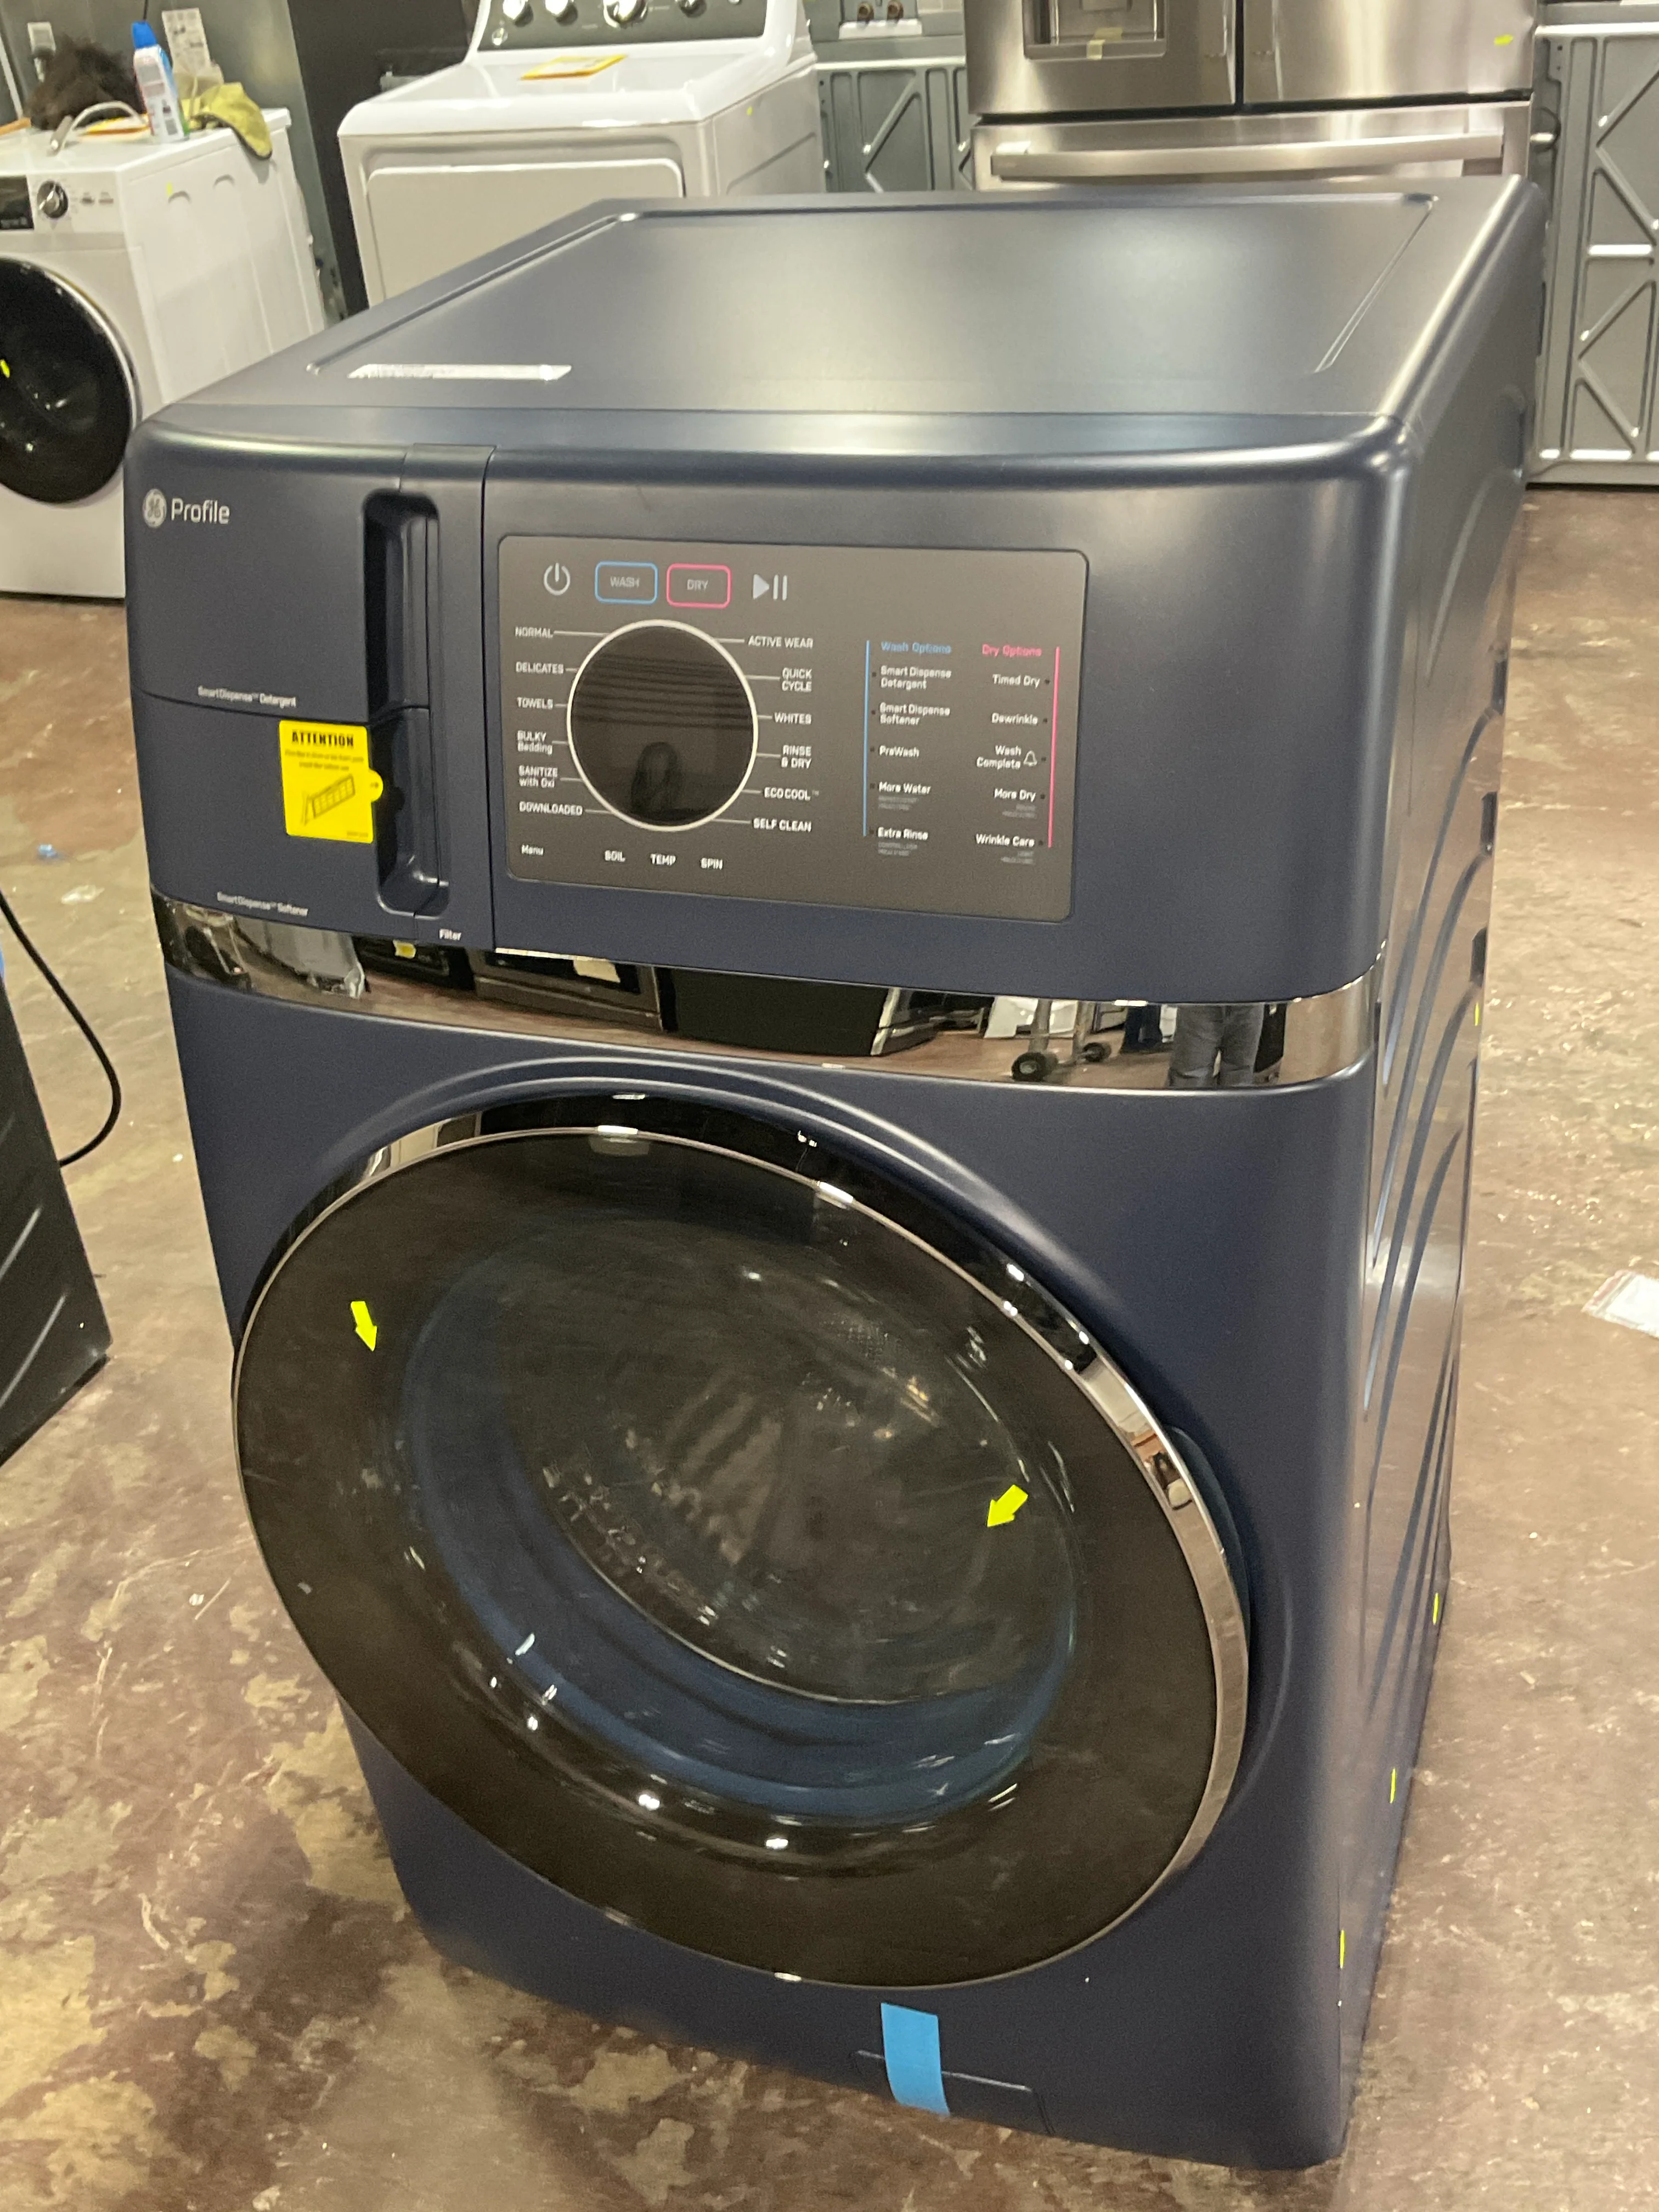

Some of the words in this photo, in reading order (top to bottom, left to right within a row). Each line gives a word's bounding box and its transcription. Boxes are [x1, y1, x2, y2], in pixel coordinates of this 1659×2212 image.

[171, 498, 230, 524] Profile
[610, 575, 640, 588] WASH
[687, 579, 708, 591] DRY
[515, 627, 553, 638] NORMAL
[748, 636, 782, 648] ACTIVE
[785, 637, 814, 648] WEAR
[881, 641, 909, 652] Wash
[912, 642, 951, 654] Options
[982, 644, 999, 657] Dry
[1002, 645, 1042, 657] Options
[516, 663, 564, 674] DELICATES
[782, 668, 812, 680] QUICK
[881, 665, 907, 677] Smart
[910, 667, 952, 679] Dispense
[782, 681, 812, 692] CYCLE
[881, 678, 927, 691] Detergent
[992, 674, 1021, 685] Timed
[1023, 675, 1040, 689] Dry
[517, 698, 554, 709] TOWELS
[879, 702, 907, 714] Smart
[909, 704, 951, 716] Dispense
[774, 713, 812, 725] WHITES
[879, 714, 920, 725] Softener
[991, 713, 1039, 725] Dewrinkle
[292, 732, 354, 746] ATTENTION
[517, 731, 546, 741] BULKY
[517, 743, 553, 755] Bedding
[782, 746, 812, 757] RINSE
[879, 746, 920, 758] PreWash
[995, 746, 1022, 756] Wash
[781, 758, 788, 768] &
[791, 758, 812, 769] DRY
[977, 757, 1021, 770] Complete
[518, 766, 558, 777] SANITIZE
[519, 777, 538, 787] with
[879, 782, 901, 793] More
[903, 784, 932, 794] Water
[994, 788, 1017, 799] More
[1019, 789, 1036, 802] Dry
[519, 802, 583, 816] DOWNLOADED
[753, 818, 777, 830] SELF
[779, 820, 812, 832] CLEAN
[878, 827, 901, 839] Extra
[903, 828, 929, 841] Rinse
[975, 833, 1011, 847] Wrinkle
[1012, 836, 1035, 848] Care
[521, 844, 544, 856] Menu
[605, 850, 625, 862] SOIL
[650, 853, 676, 865] TEMP
[701, 857, 723, 870] SPIN
[439, 929, 462, 941] Filter
